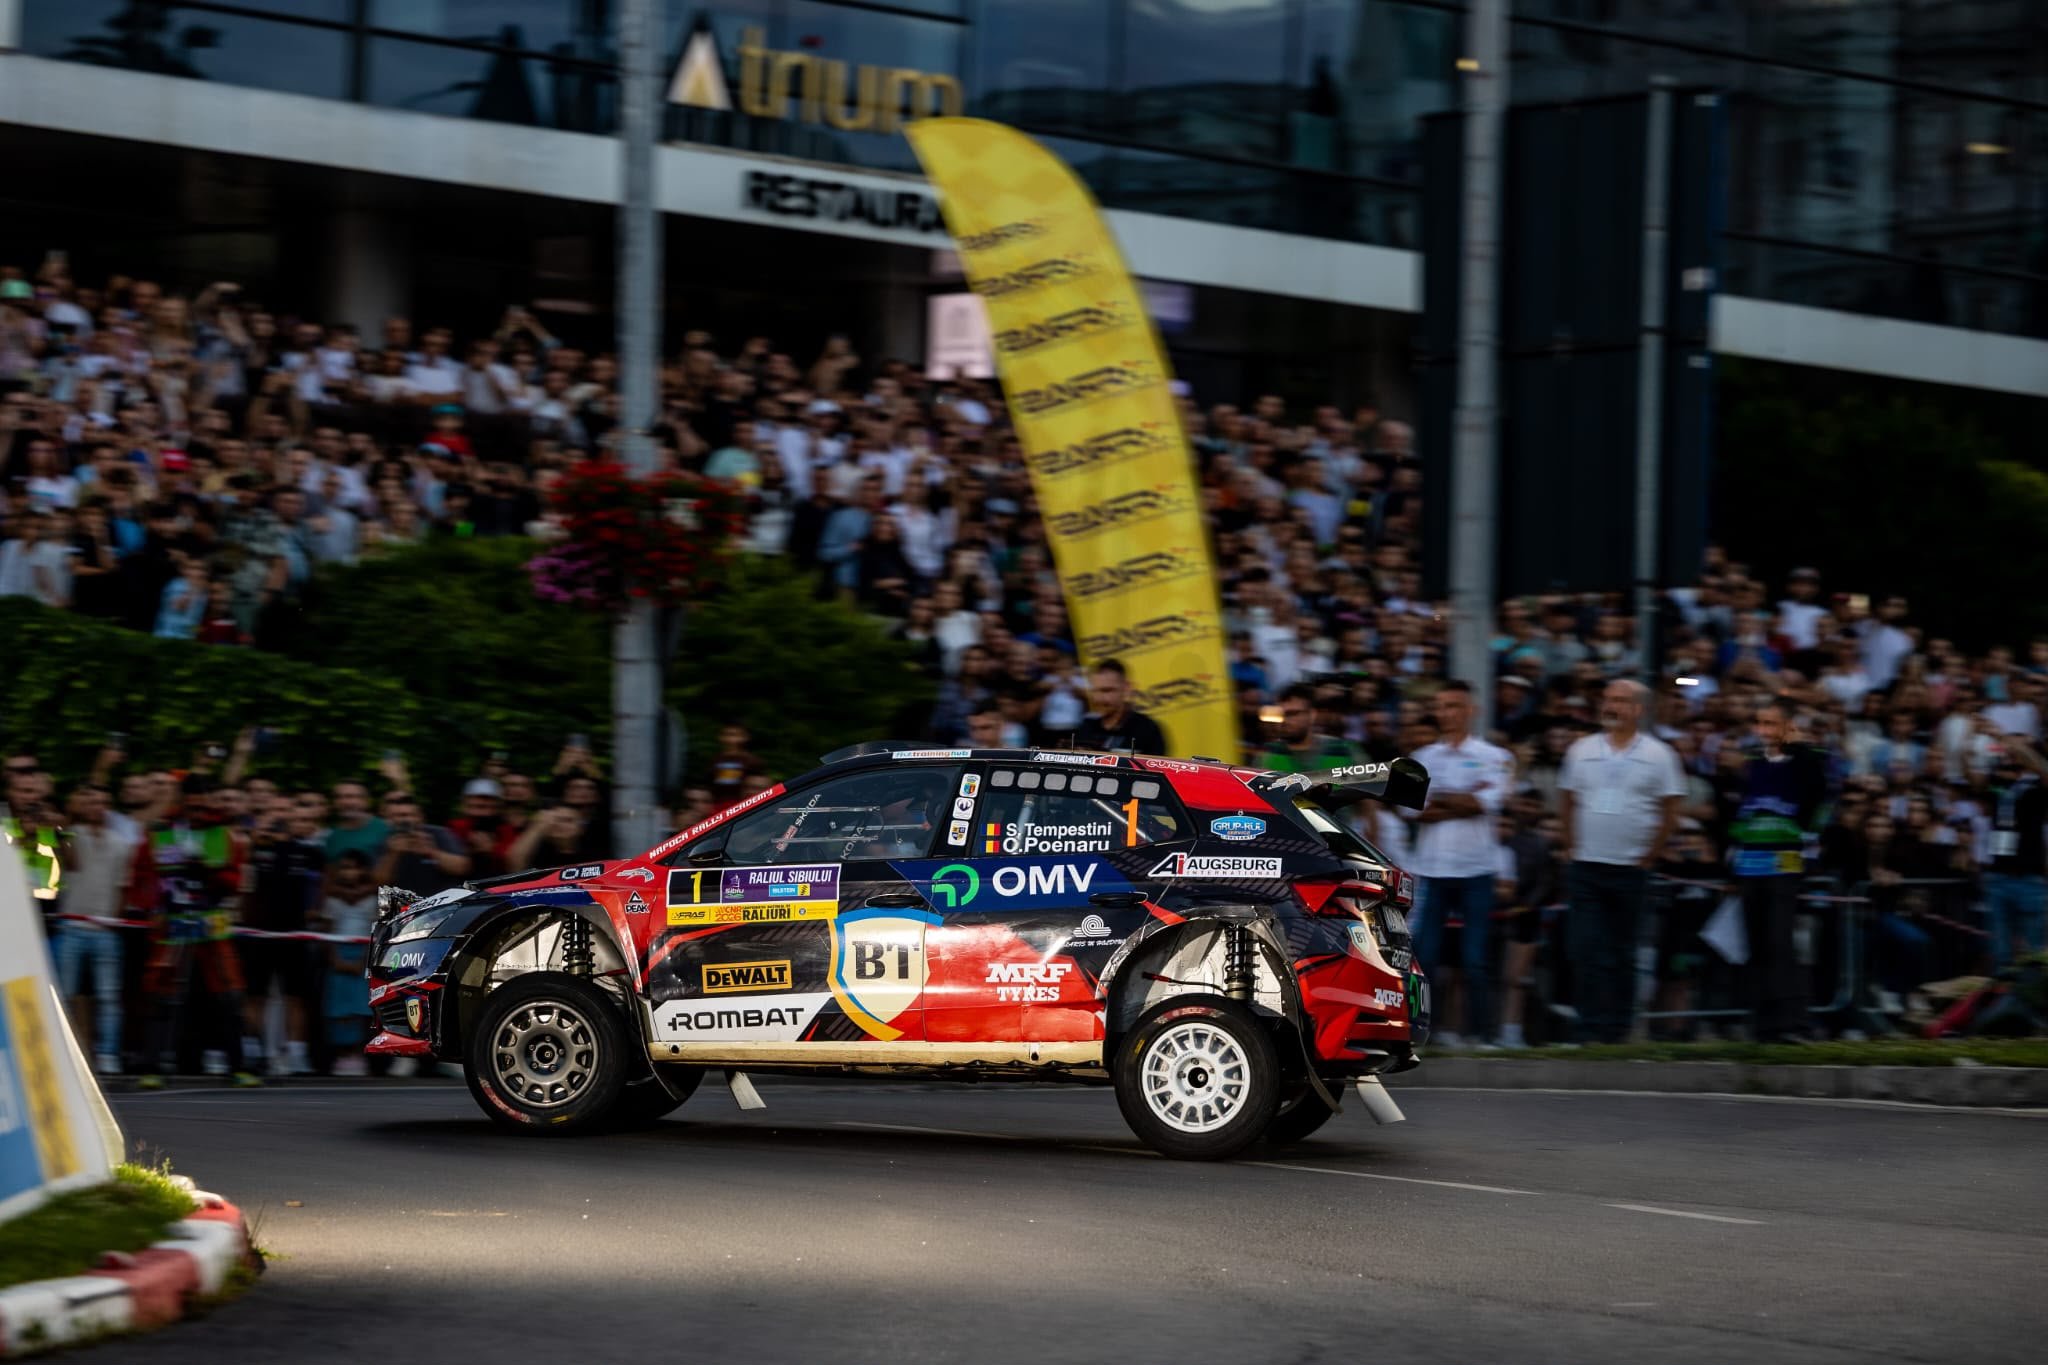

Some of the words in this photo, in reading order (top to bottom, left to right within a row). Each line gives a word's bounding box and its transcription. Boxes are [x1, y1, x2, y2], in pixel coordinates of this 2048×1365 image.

[1331, 762, 1389, 778] SKODA
[649, 833, 688, 859] NAPOCA
[691, 814, 723, 835] RALLY
[726, 789, 773, 817] ACADEMY
[1006, 822, 1021, 836] S.
[1025, 822, 1111, 839] Tempestini
[1122, 799, 1139, 847] 1
[1187, 859, 1278, 871] AUGSBURG
[690, 871, 702, 903] 1
[749, 872, 785, 884] RALIUL
[788, 870, 832, 883] SIBIULUI
[992, 862, 1098, 897] OMV
[743, 908, 790, 921] RALIURI
[401, 953, 425, 968] OMV
[852, 941, 920, 980] BT
[985, 963, 1072, 983] MRF
[996, 986, 1060, 1001] TYRES
[1374, 987, 1404, 1008] MRF
[668, 1008, 804, 1031] ROMBAT
